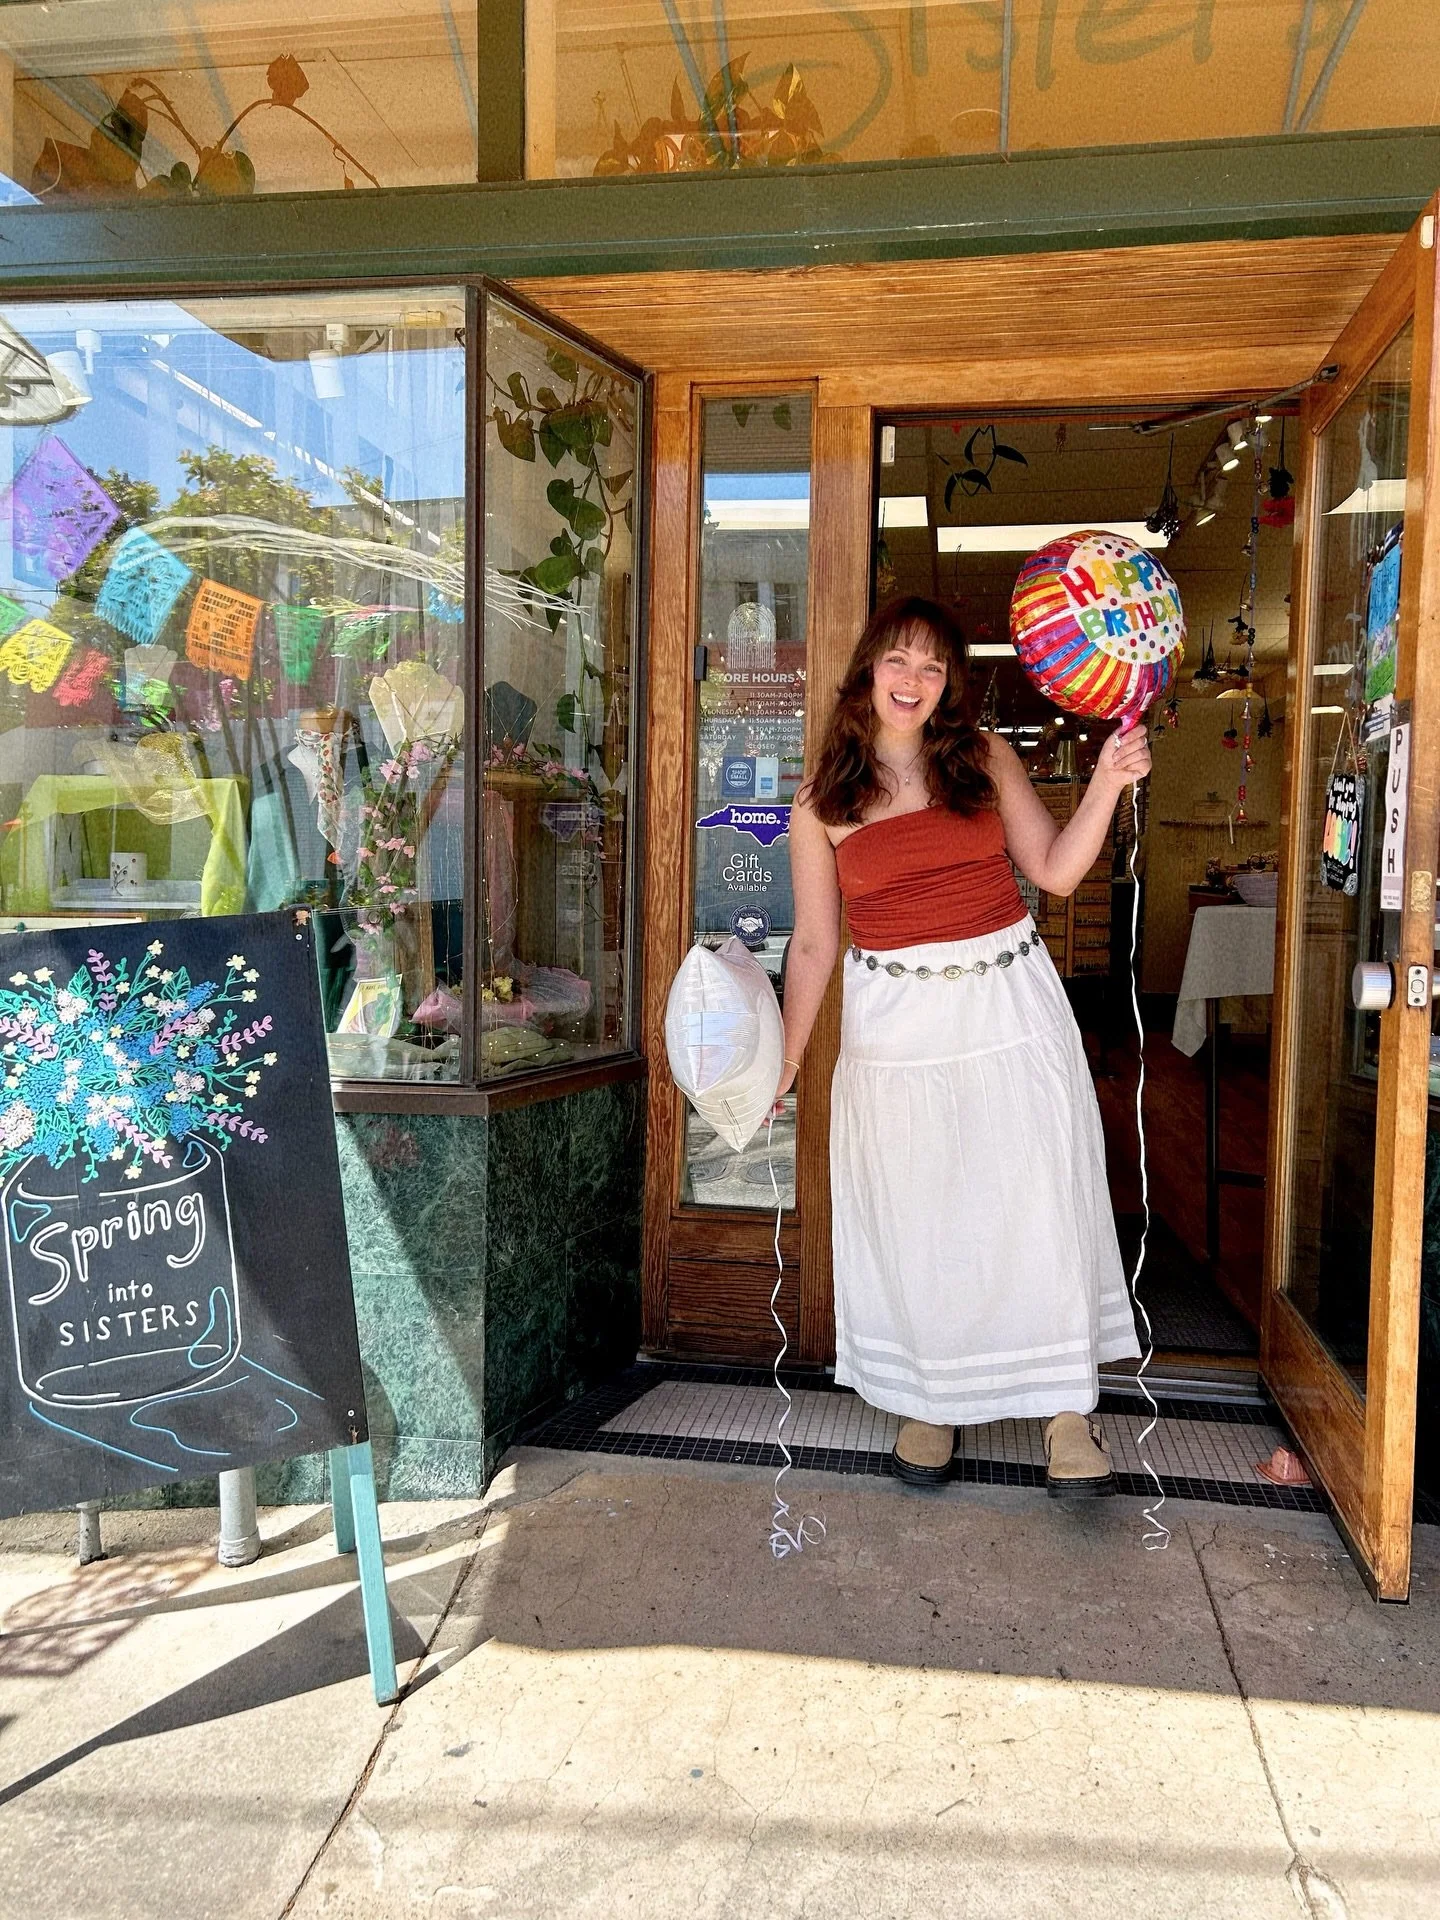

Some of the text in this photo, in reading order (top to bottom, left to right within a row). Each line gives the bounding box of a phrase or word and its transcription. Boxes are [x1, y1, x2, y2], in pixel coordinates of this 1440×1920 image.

[1058, 551, 1168, 607] HAPPY
[1079, 588, 1181, 640] BIRTHDAY
[752, 673, 795, 683] HOURS
[1387, 728, 1403, 874] PUSH
[730, 808, 781, 824] home.
[730, 853, 760, 869] Gift
[722, 866, 773, 882] Cards
[727, 883, 767, 892] Available
[28, 1192, 206, 1306] Spring
[108, 1279, 154, 1304] into
[59, 1301, 199, 1347] SISTERS
